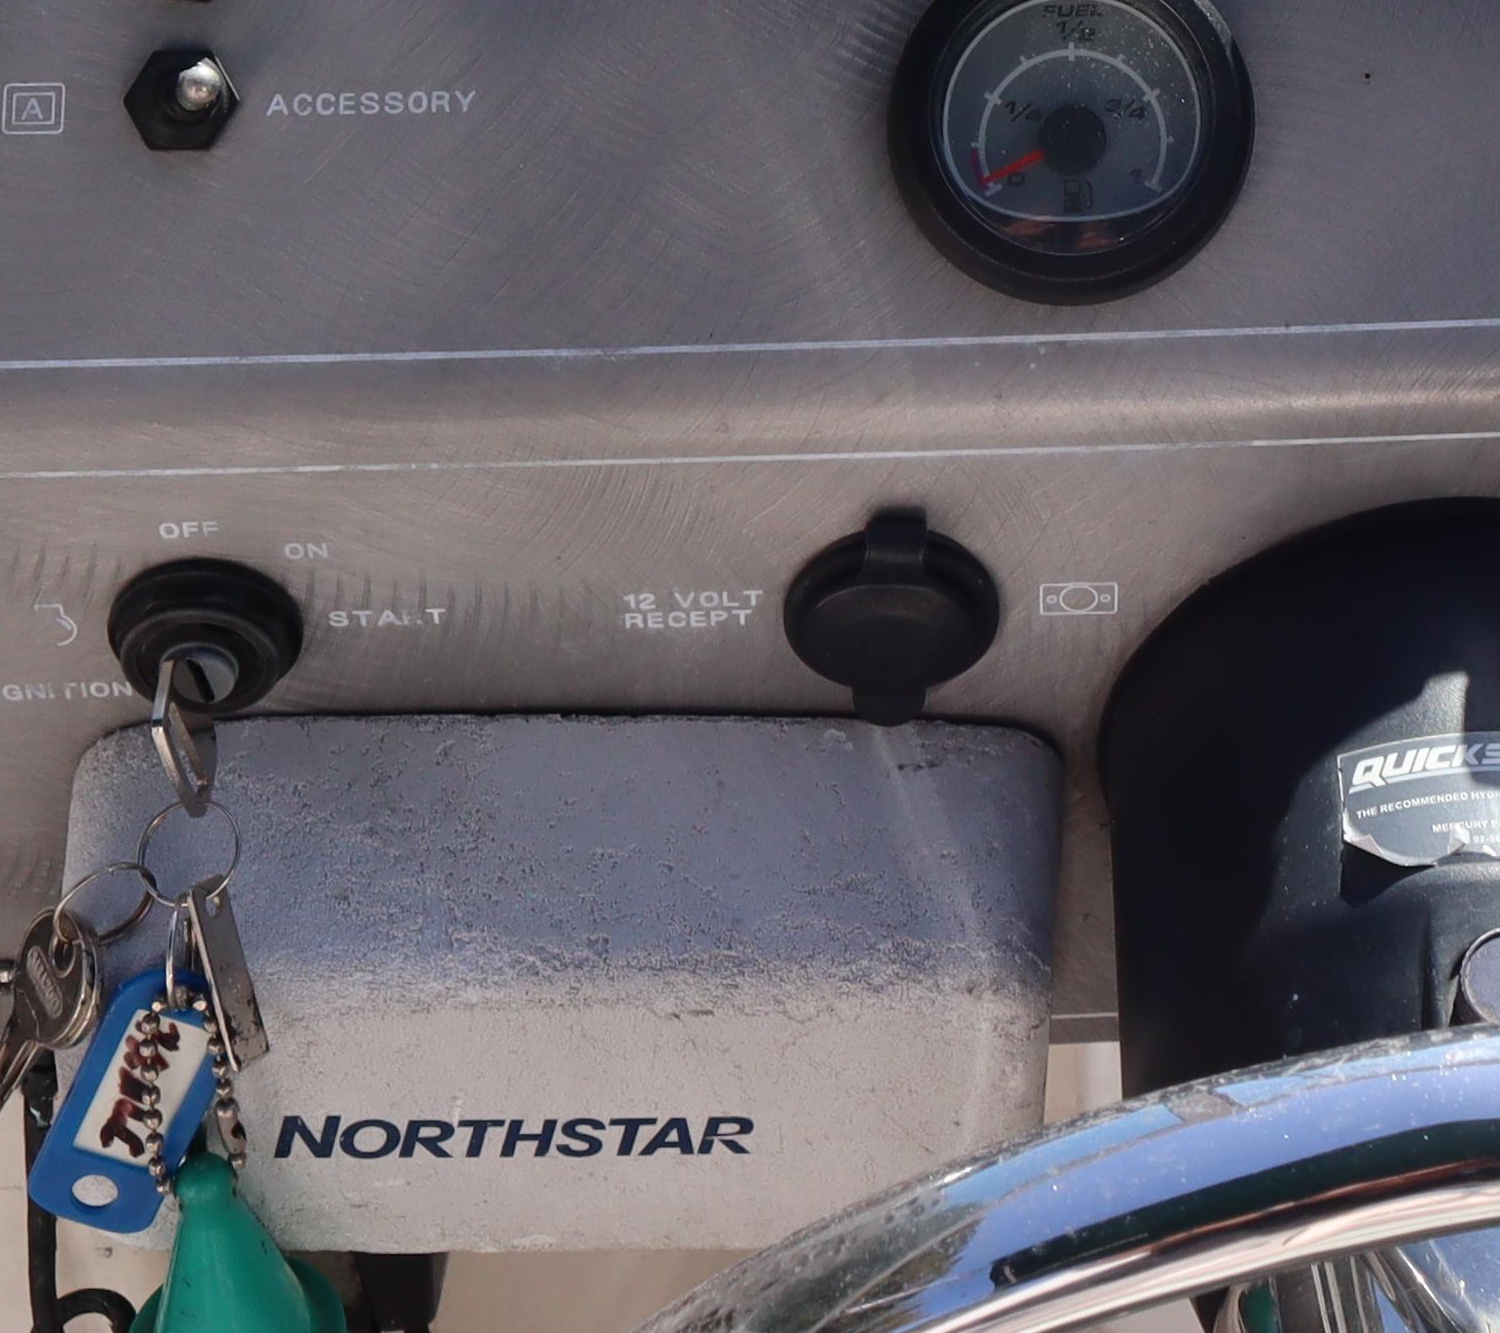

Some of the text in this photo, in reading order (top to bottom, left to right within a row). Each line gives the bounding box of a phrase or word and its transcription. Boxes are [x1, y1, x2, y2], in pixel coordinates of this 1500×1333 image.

[1042, 3, 1106, 20] FUEL
[266, 90, 477, 116] ACCESSORY
[159, 520, 220, 541] OFF
[284, 541, 329, 561] ON
[623, 588, 765, 611] 12 VOLT
[624, 608, 754, 630] RECEPT
[1355, 806, 1379, 821] THE
[1379, 790, 1469, 814] RECOMMENDED
[273, 1114, 755, 1159] NORTHSTAR
